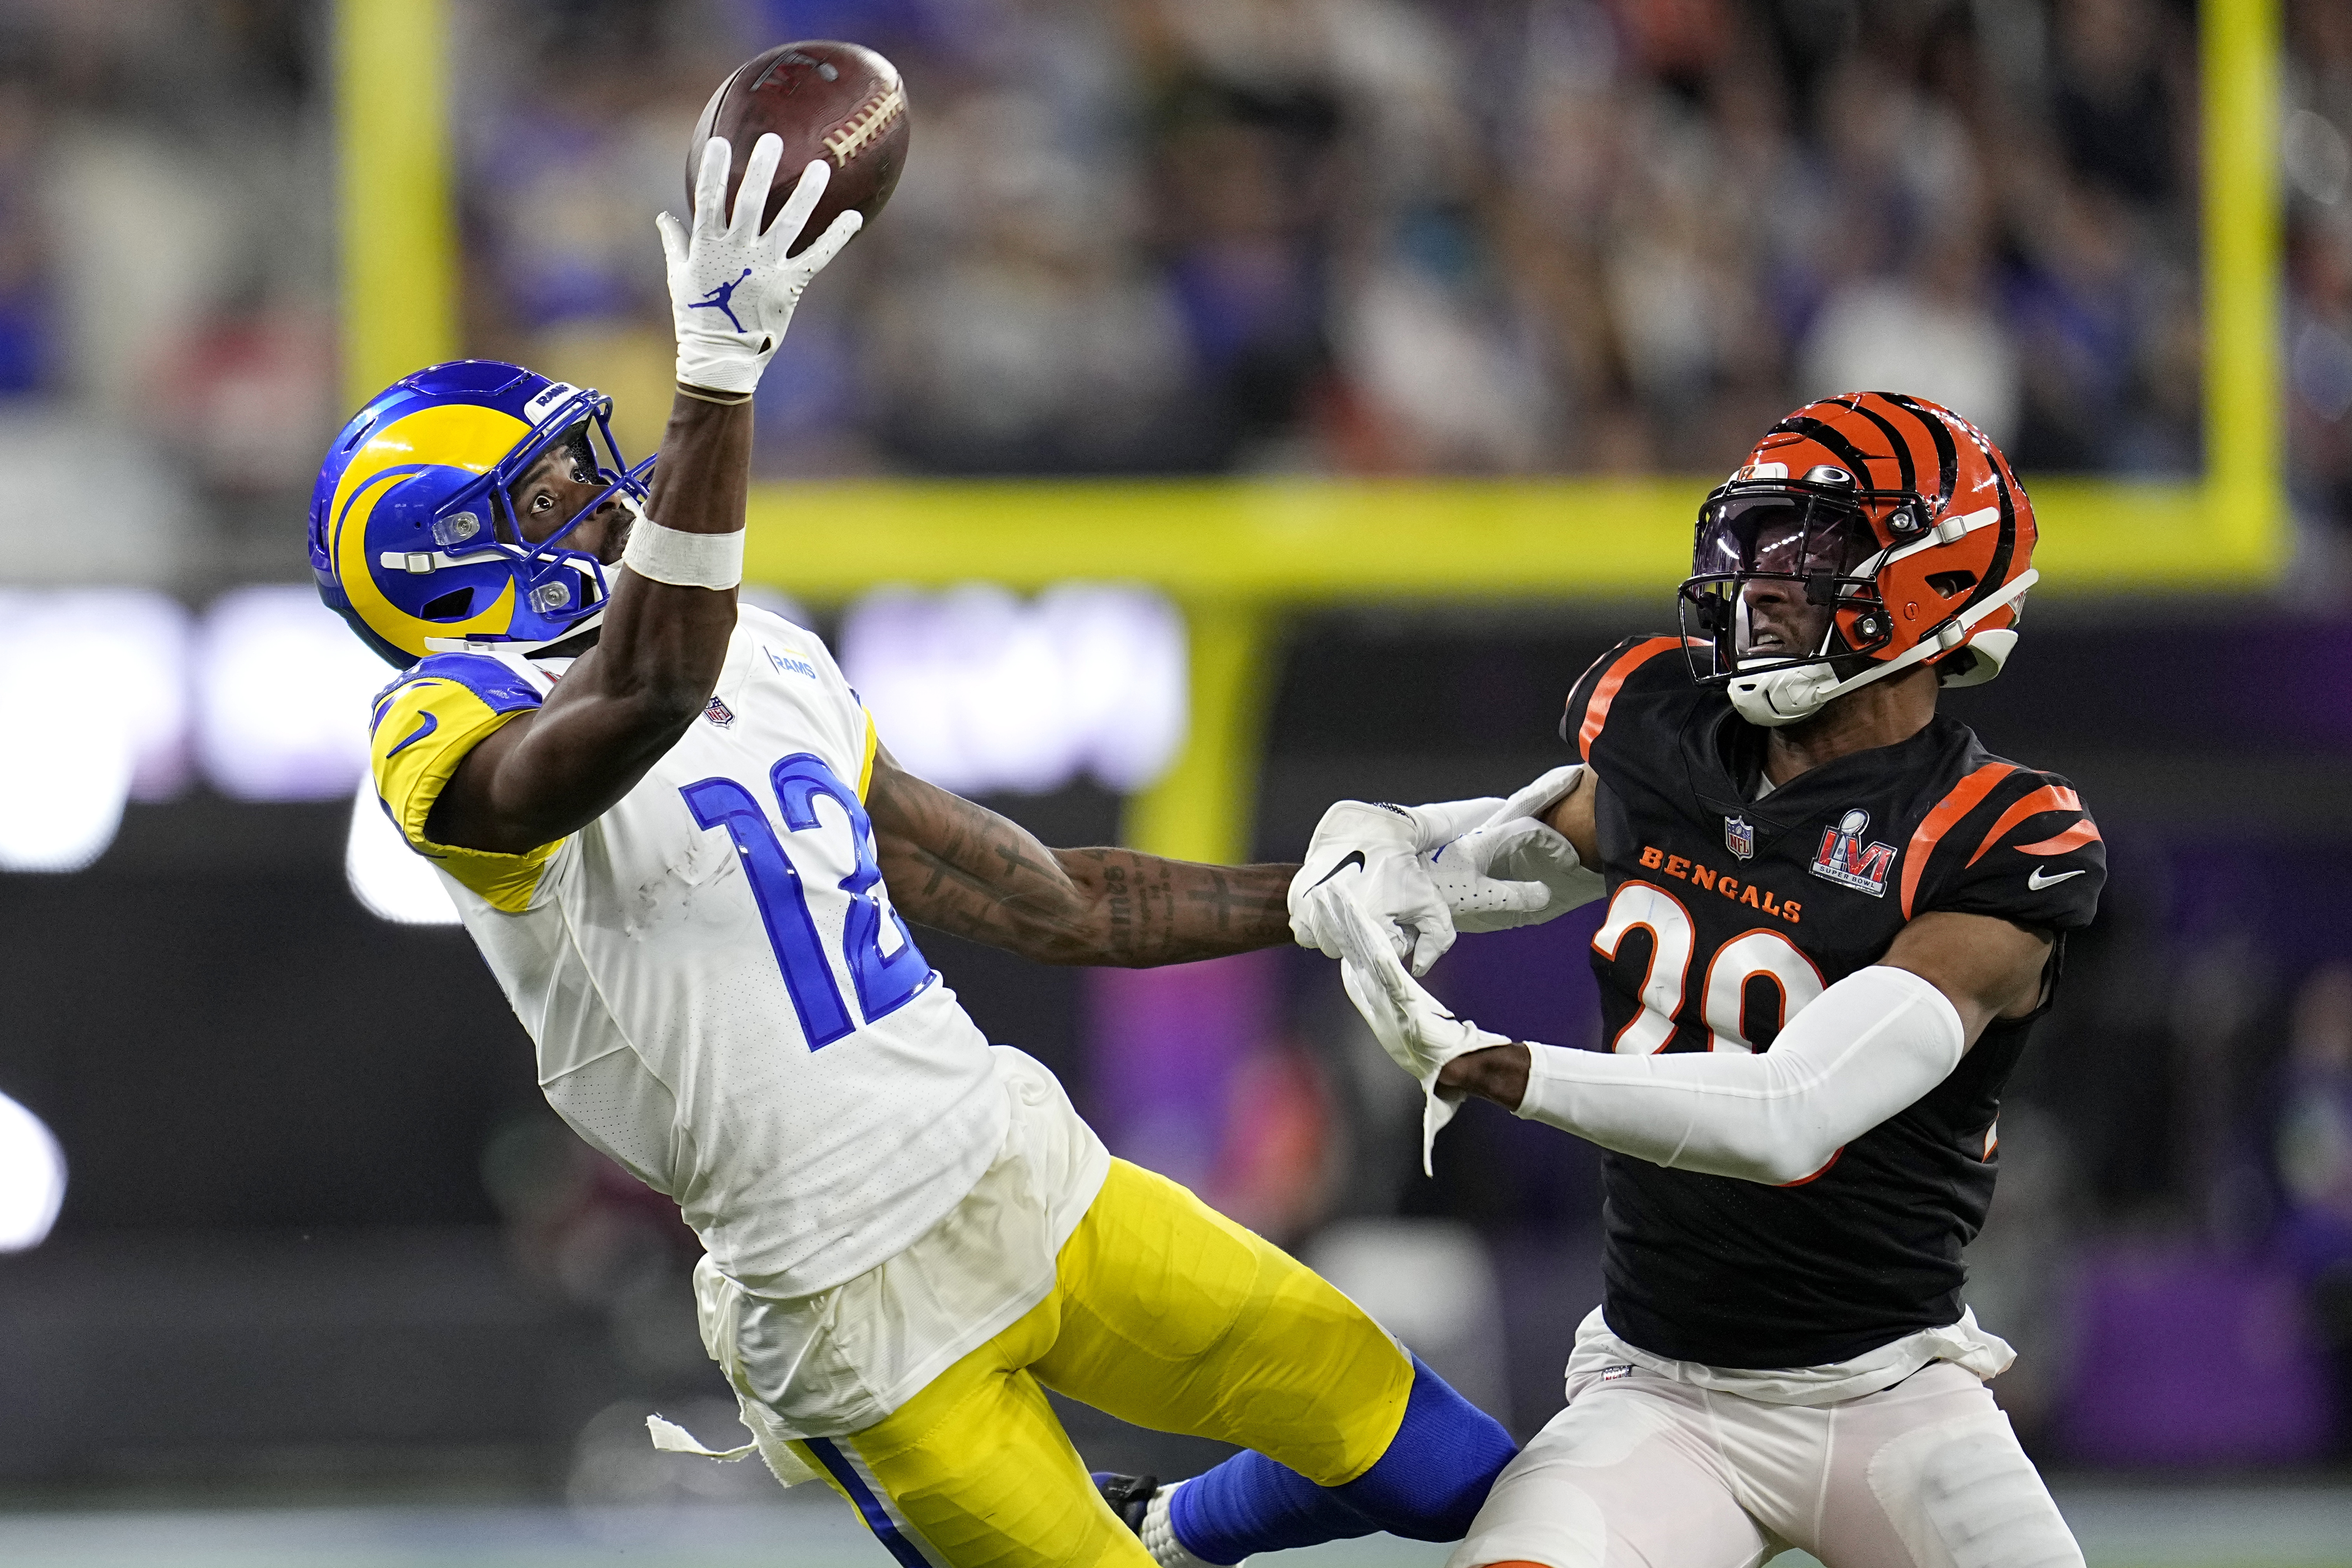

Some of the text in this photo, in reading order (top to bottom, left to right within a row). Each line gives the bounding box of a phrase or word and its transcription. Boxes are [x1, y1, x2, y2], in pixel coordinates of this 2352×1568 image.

[536, 384, 569, 407] RAMS
[771, 654, 816, 679] RAMS
[705, 707, 730, 720] NFL
[1729, 834, 1749, 853] NFL
[1639, 846, 1802, 924] BENGALS
[1820, 866, 1875, 889] SUPER BOWL
[679, 752, 937, 1053] 12
